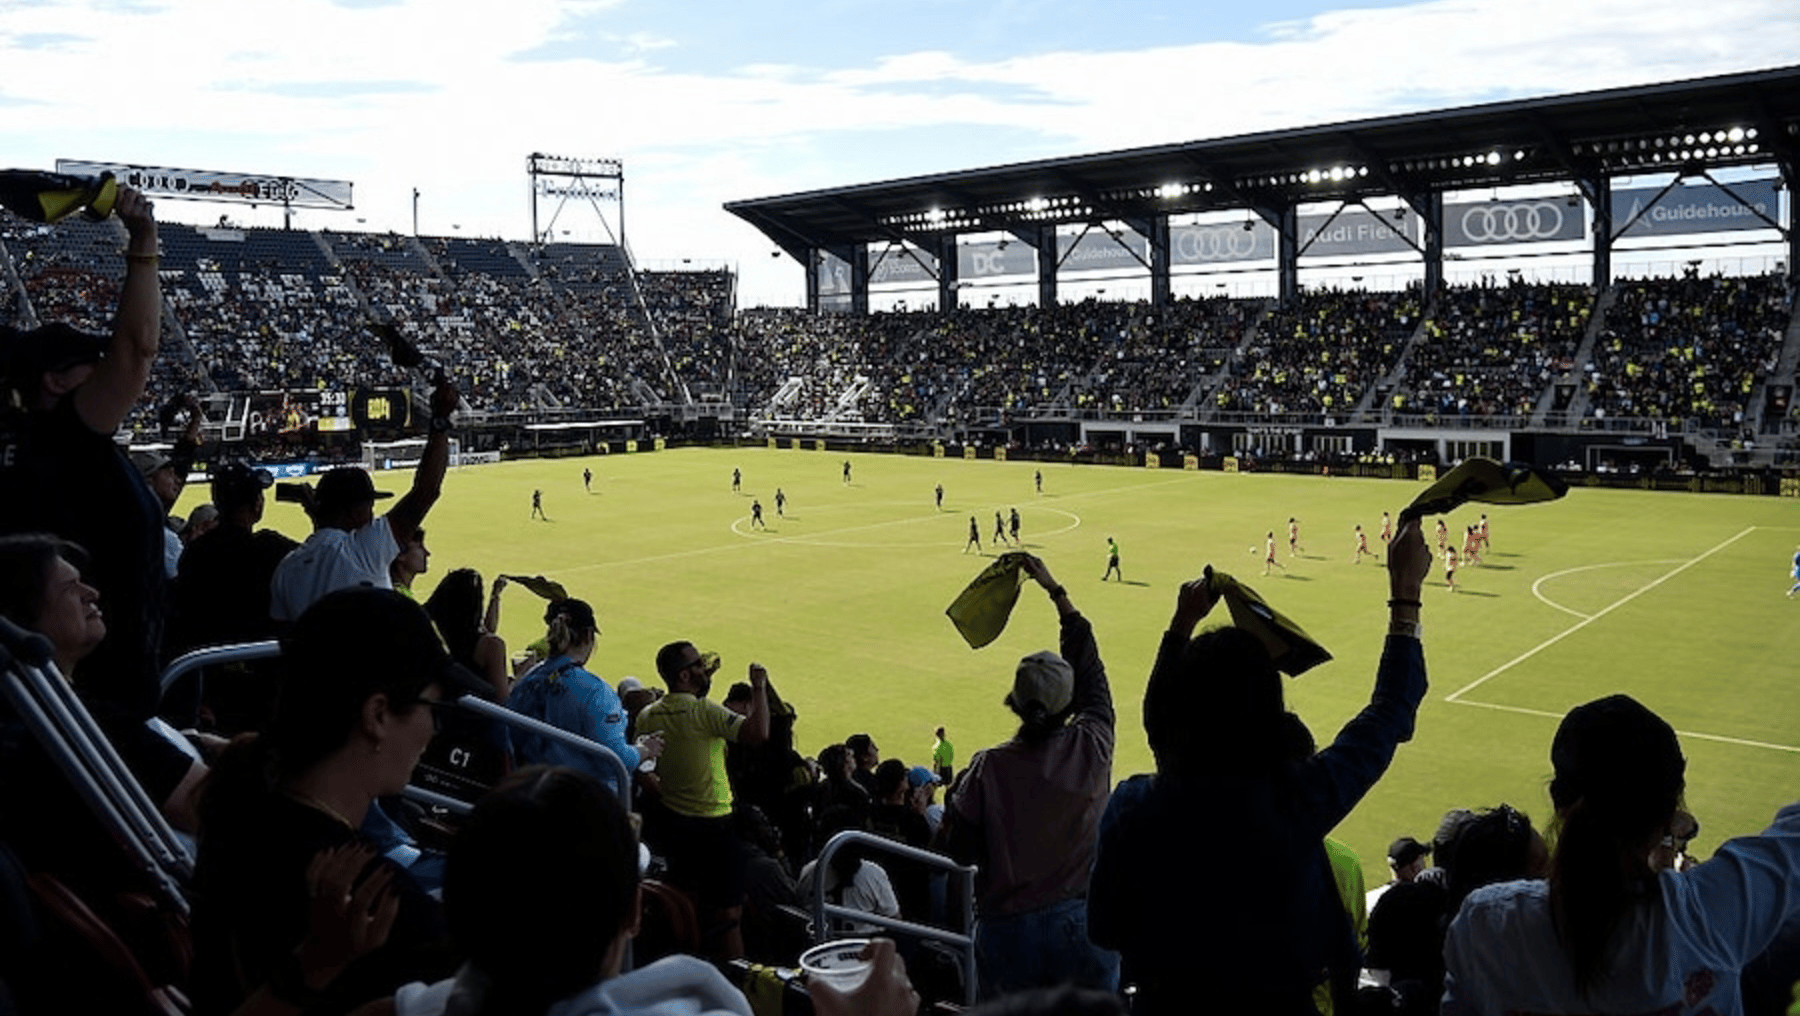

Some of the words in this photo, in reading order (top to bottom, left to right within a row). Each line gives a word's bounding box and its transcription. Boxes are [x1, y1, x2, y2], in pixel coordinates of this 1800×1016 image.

[1303, 225, 1352, 244] Audi
[972, 250, 1005, 275] DC
[0, 443, 18, 468] E
[449, 746, 471, 768] C1
